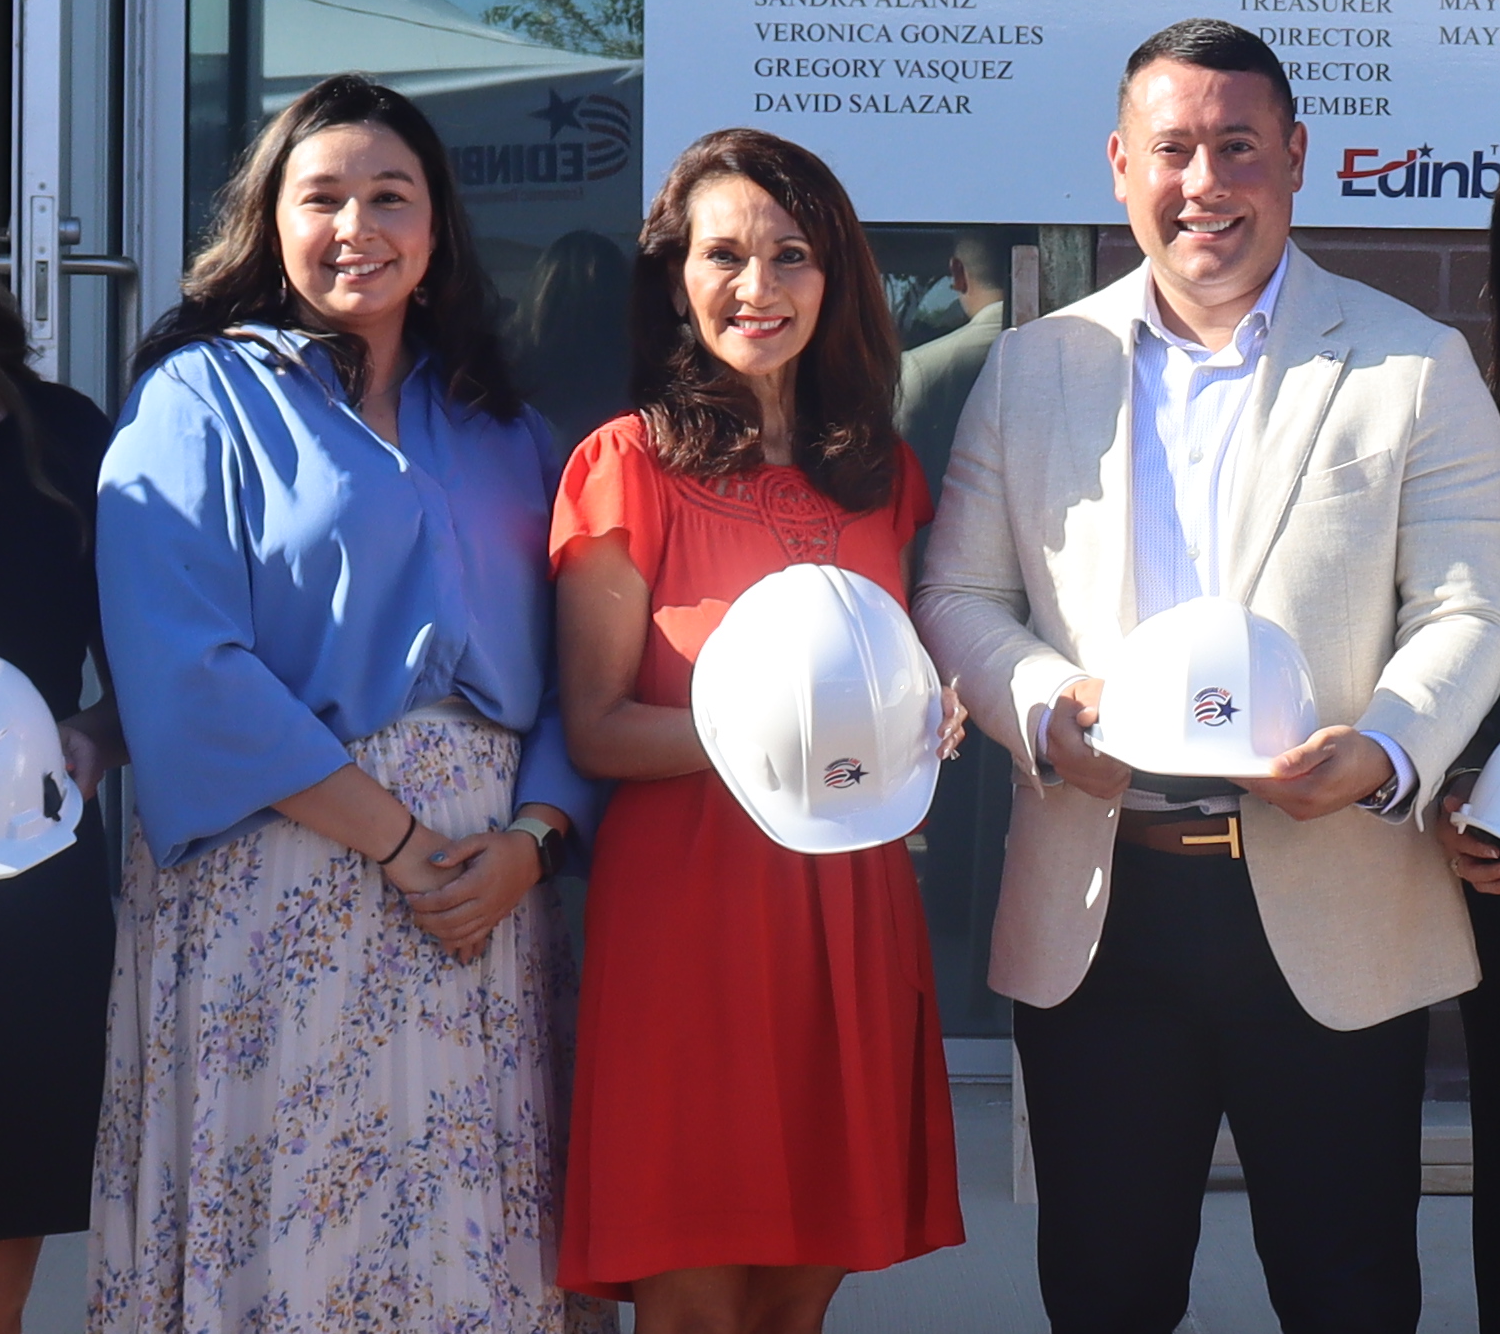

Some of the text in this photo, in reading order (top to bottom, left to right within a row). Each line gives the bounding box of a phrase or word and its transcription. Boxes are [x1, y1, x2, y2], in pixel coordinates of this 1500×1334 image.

[754, 22, 1044, 46] VERONICA GONZALES
[1259, 27, 1392, 47] DIRECTOR
[753, 57, 1014, 84] GREGORY VASQUEZ
[754, 92, 973, 115] DAVID SALAZAR
